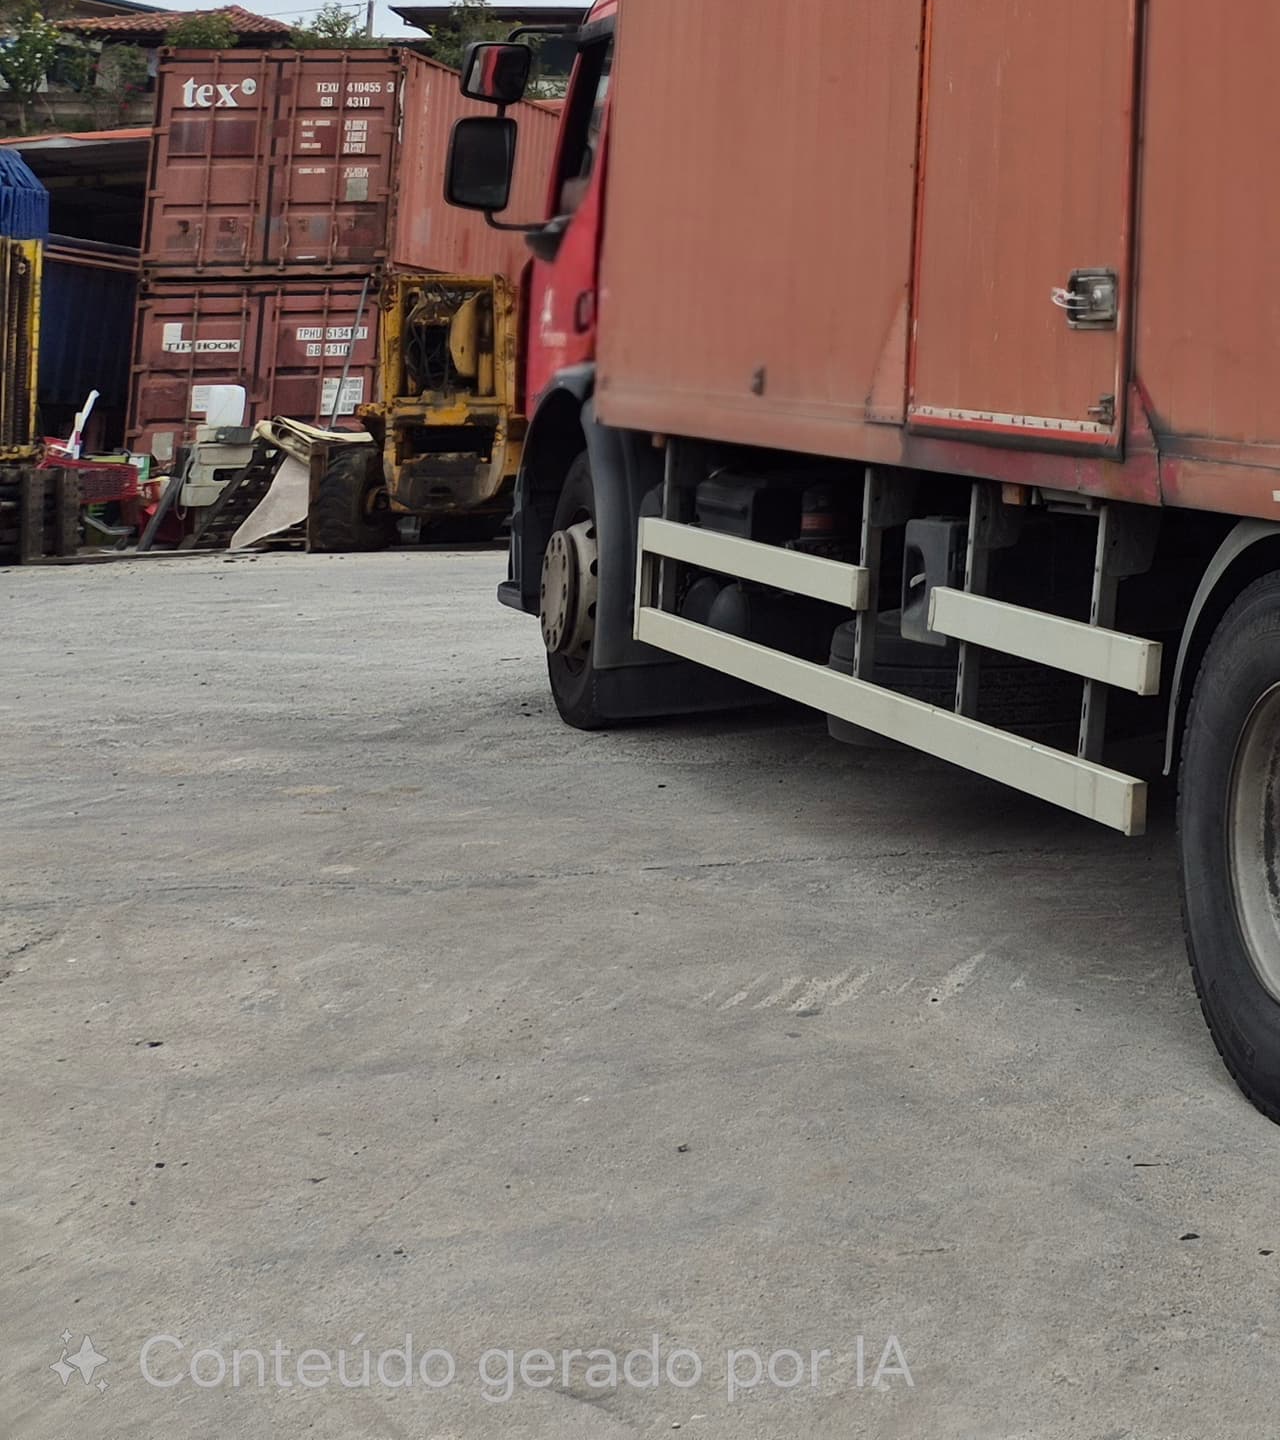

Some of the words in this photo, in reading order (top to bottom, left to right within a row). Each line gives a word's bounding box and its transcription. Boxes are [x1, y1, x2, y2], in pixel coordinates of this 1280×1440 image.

[182, 77, 239, 107] tex
[316, 82, 340, 93] TEXU
[346, 82, 381, 93] 410455
[386, 82, 395, 93] 3
[346, 97, 371, 107] 4310
[299, 328, 322, 339] TPHU
[196, 342, 238, 350] HOOK
[308, 344, 321, 355] GB
